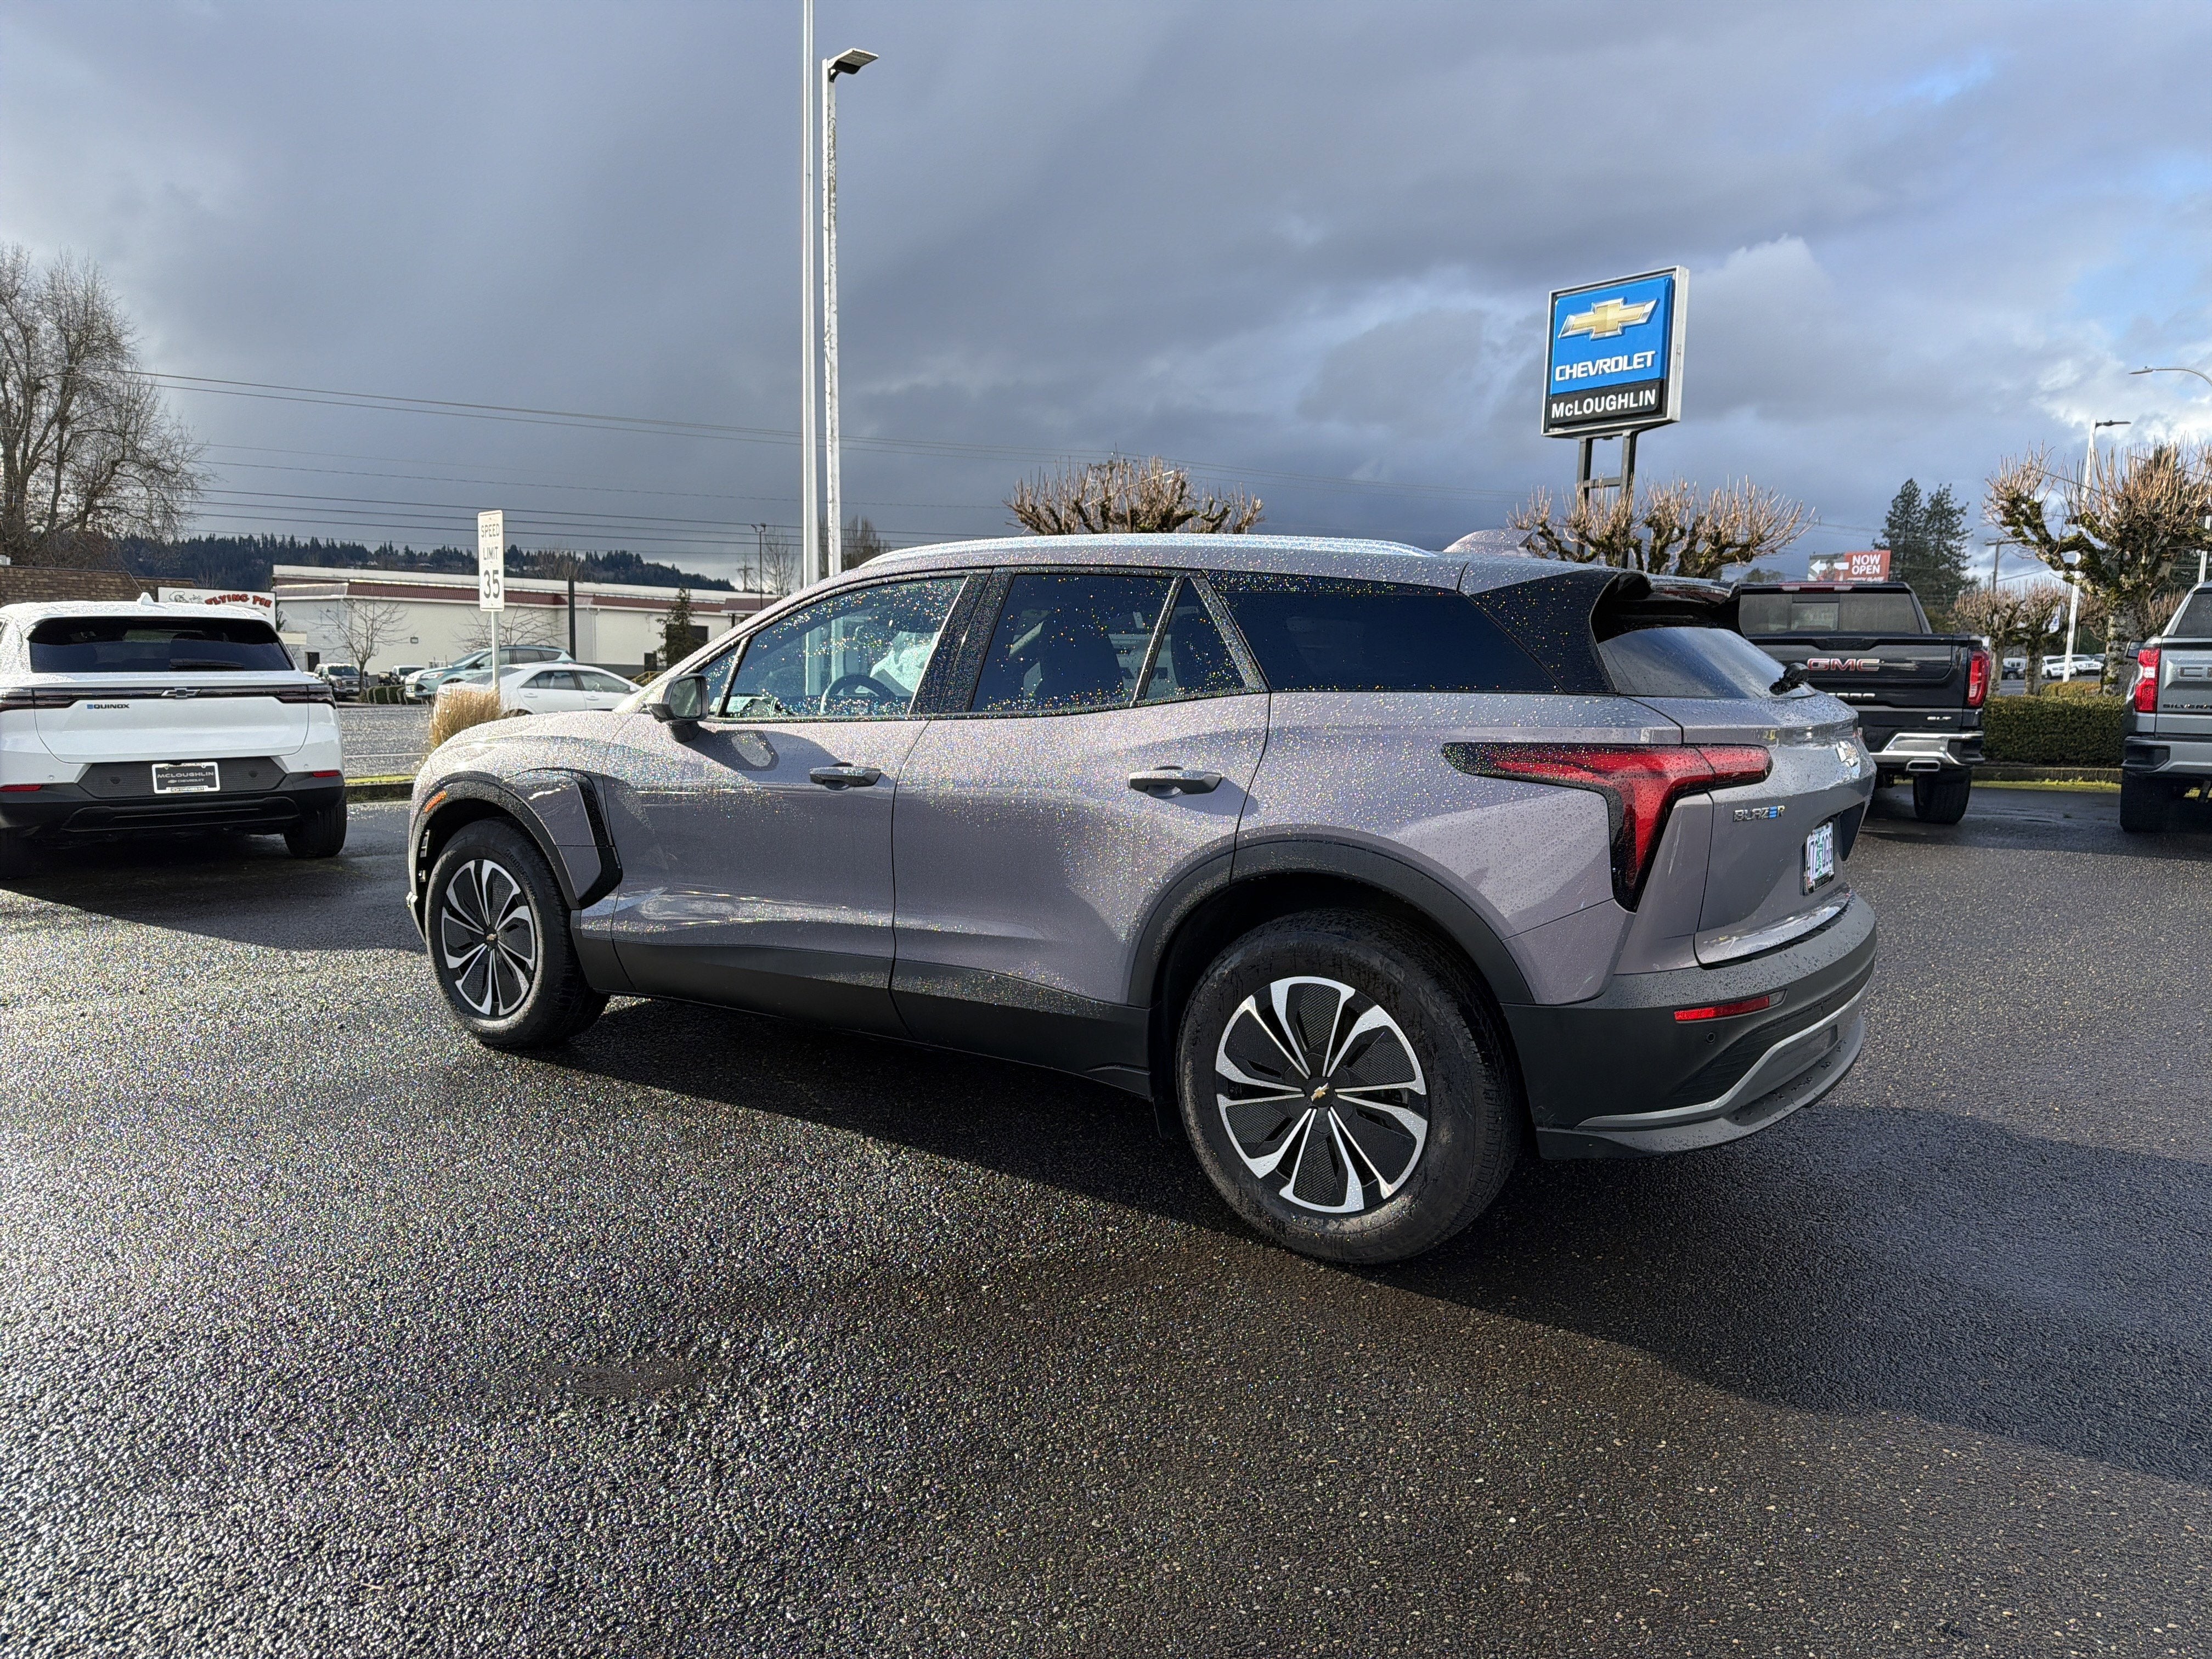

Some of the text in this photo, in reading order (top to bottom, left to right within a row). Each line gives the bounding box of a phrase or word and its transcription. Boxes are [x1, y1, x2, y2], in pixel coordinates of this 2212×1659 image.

[1555, 350, 1656, 382] CHEVROLET
[1551, 388, 1656, 419] McLOUGHLIN
[481, 523, 500, 538] SPEED
[483, 546, 499, 561] LIMIT
[1852, 554, 1881, 566] NOW
[1851, 564, 1881, 575] OPEN
[483, 569, 500, 599] 35
[205, 594, 273, 608] FLYING PIE
[1807, 658, 1880, 672] GMC
[1733, 805, 1785, 822] BLAZER
[1807, 839, 1819, 877] 472
